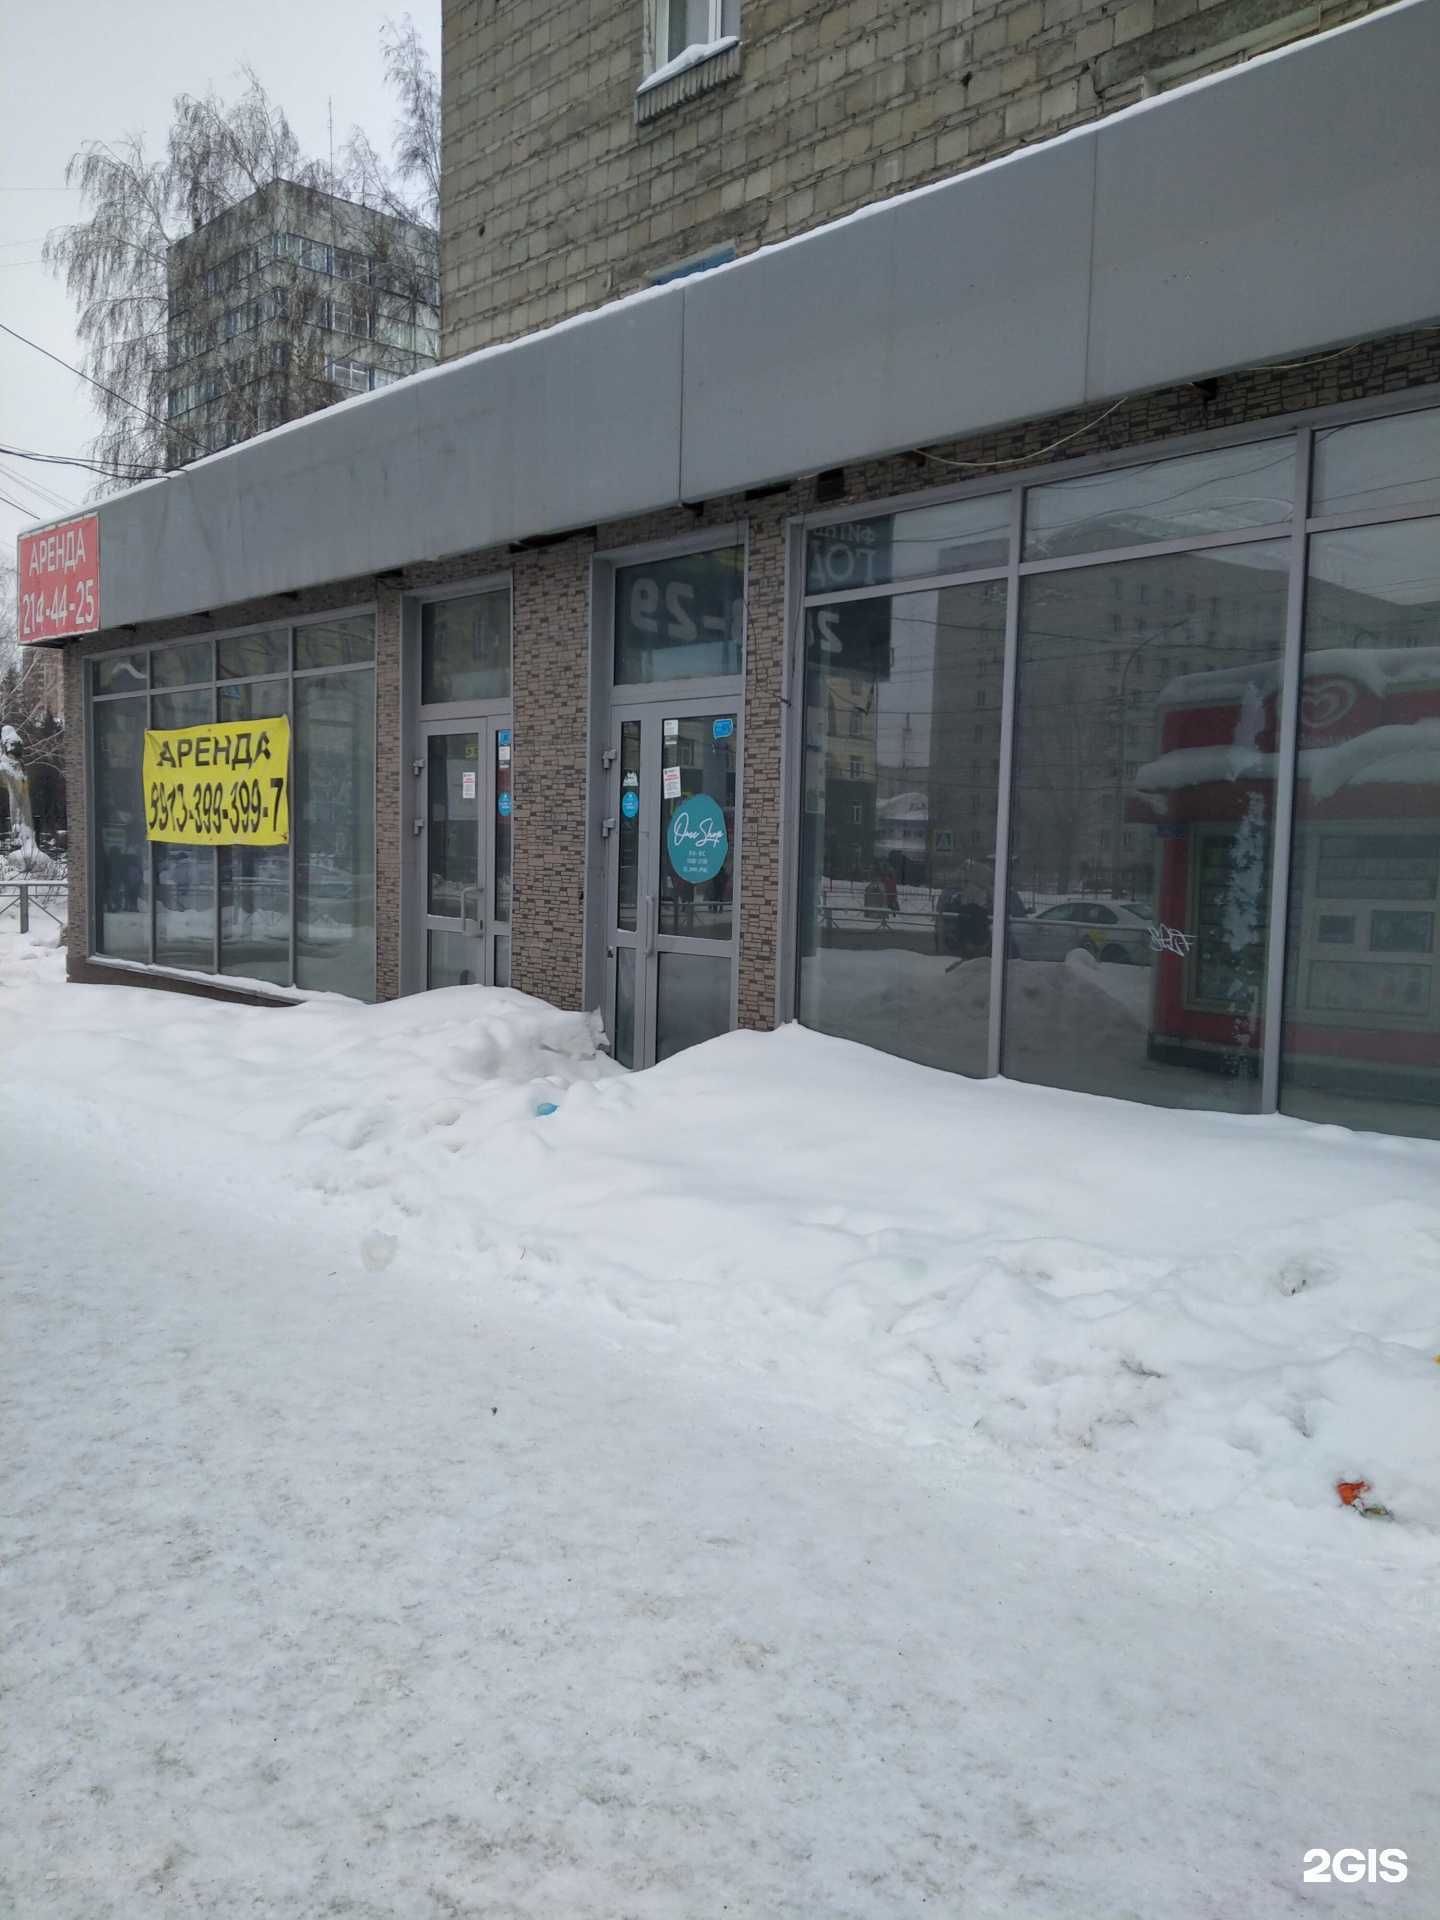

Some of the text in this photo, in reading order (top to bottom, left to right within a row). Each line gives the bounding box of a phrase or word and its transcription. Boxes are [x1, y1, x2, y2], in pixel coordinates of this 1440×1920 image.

[29, 527, 87, 576] АРЕНДА
[23, 579, 95, 634] 214-44-25
[156, 731, 271, 771] АРЕНДА
